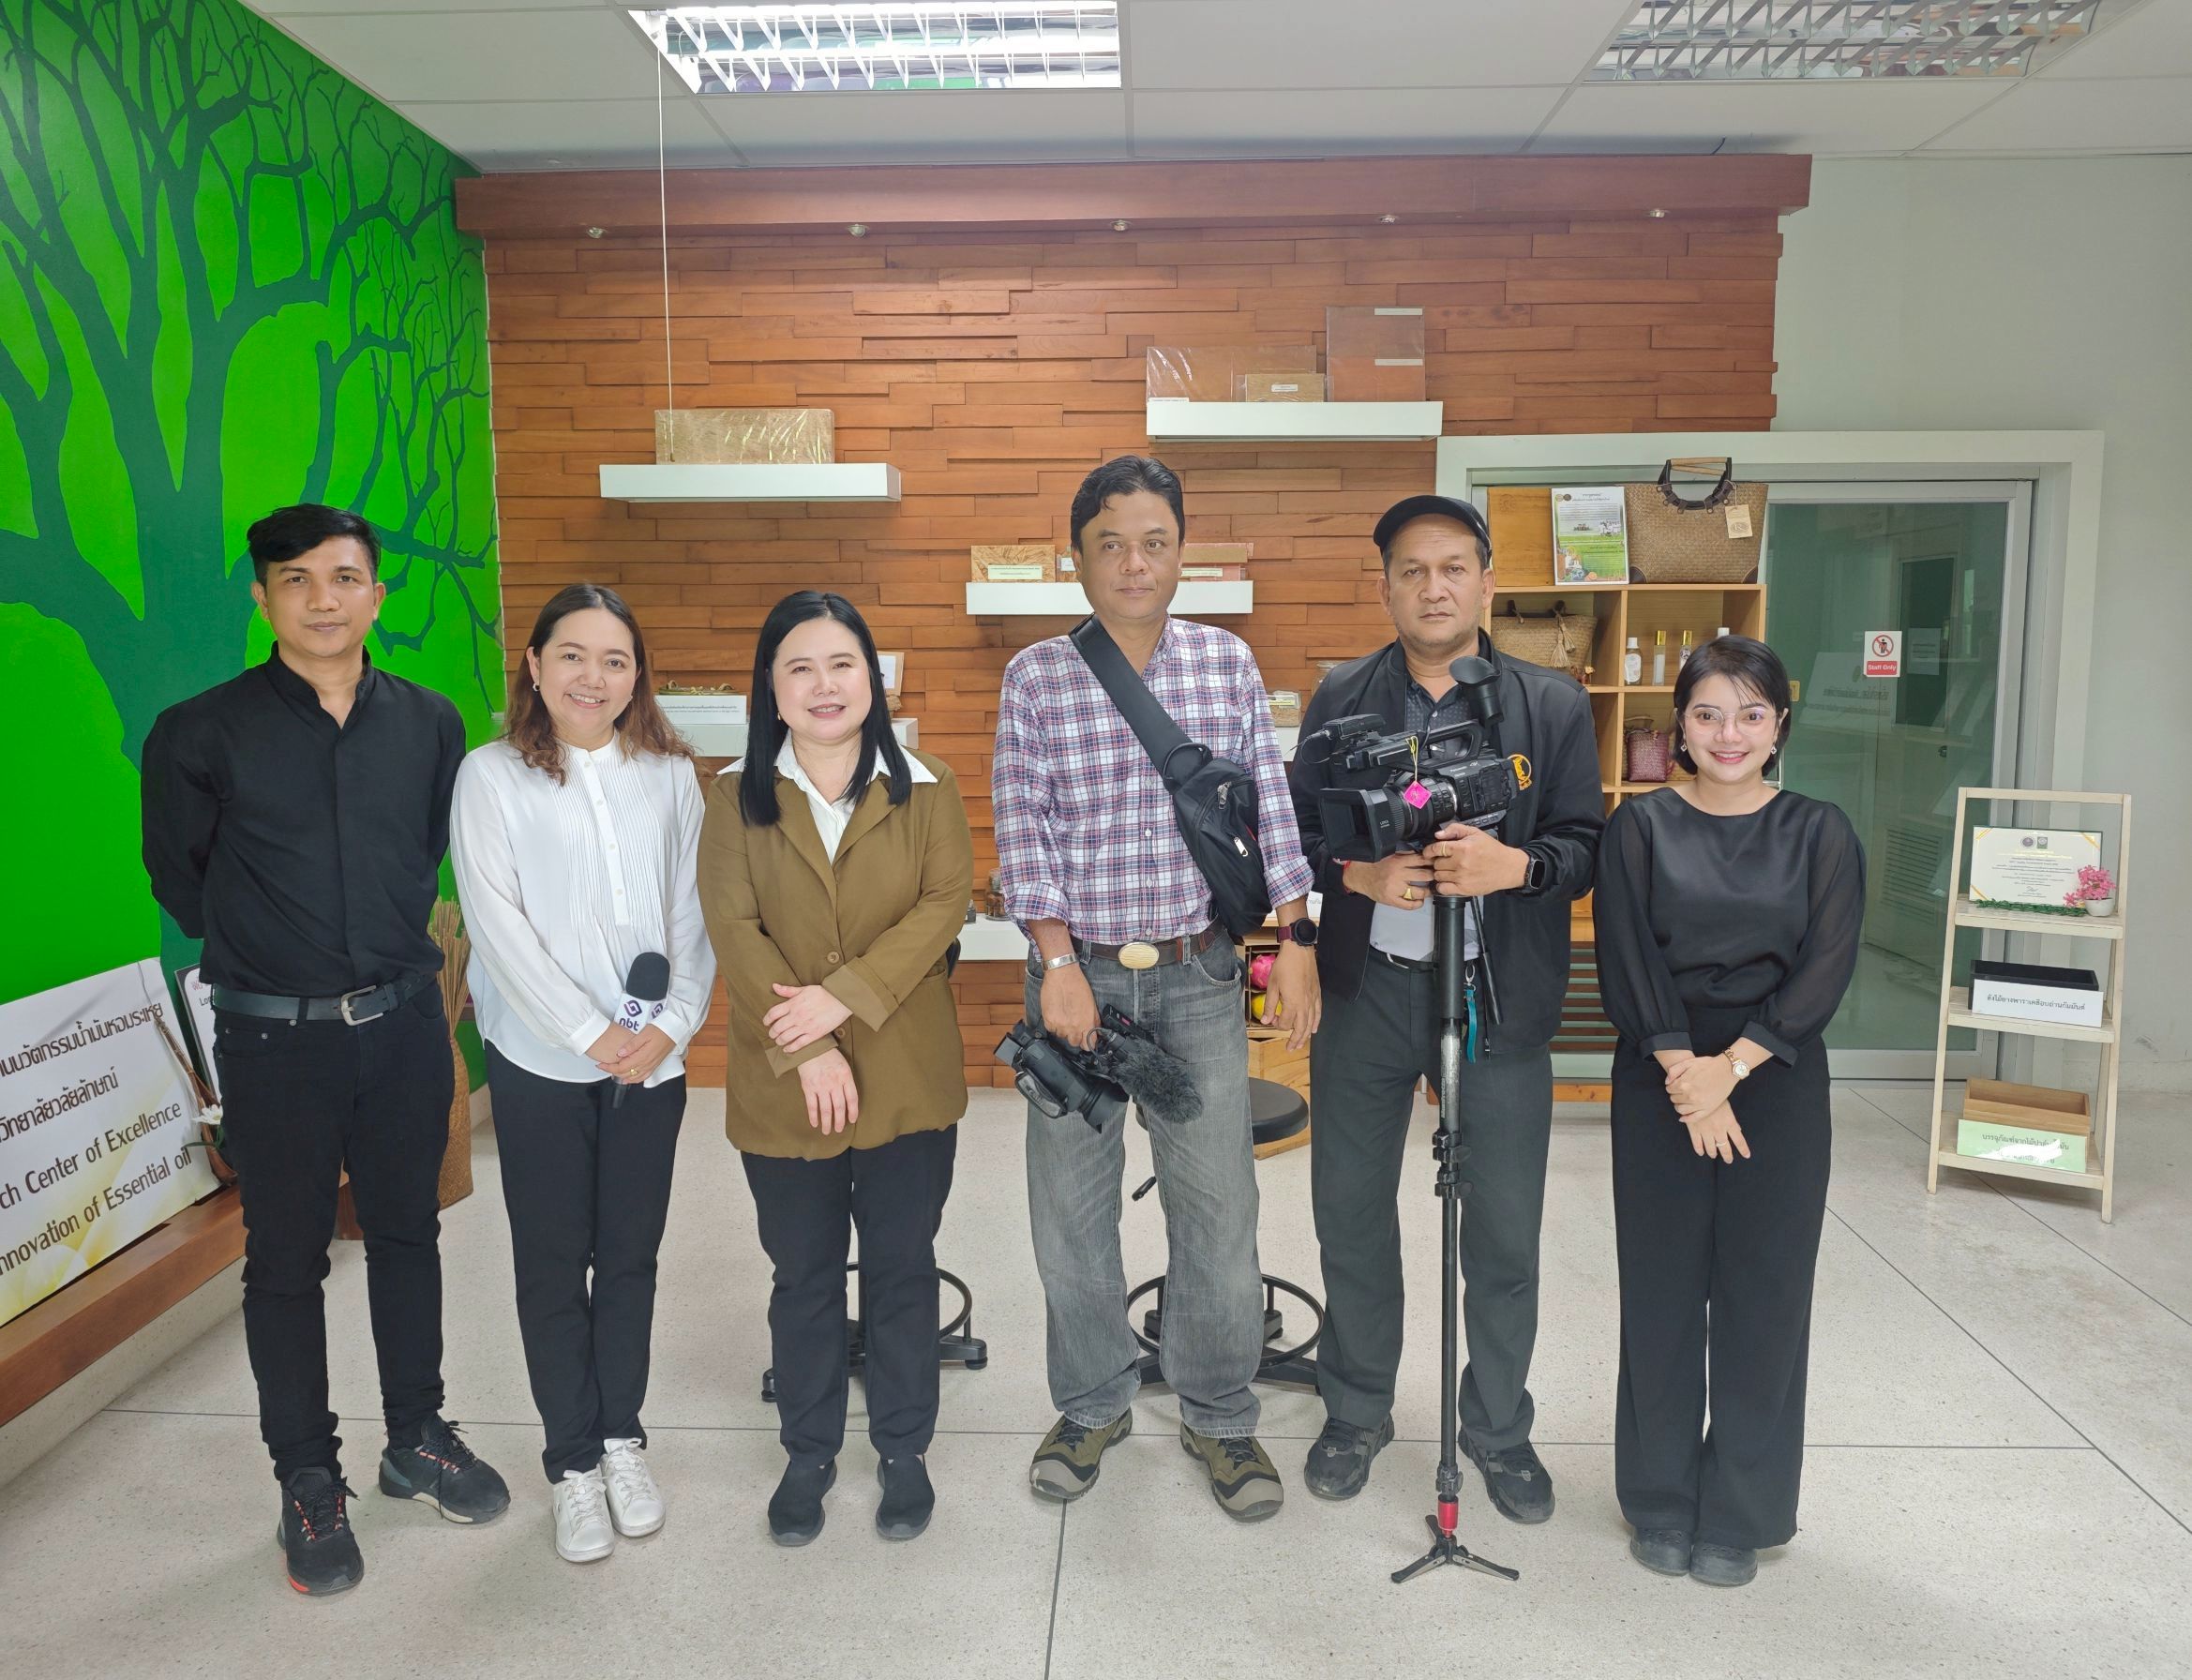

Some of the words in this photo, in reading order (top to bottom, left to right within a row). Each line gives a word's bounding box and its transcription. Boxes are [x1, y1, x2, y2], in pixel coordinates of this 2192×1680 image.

[619, 1017, 639, 1031] nbt
[0, 1066, 119, 1143] วิทยาลัยวลัยลักษณ์
[25, 1153, 79, 1194] Center
[85, 1137, 103, 1163] of
[104, 1102, 182, 1152] Excellence
[83, 1195, 101, 1222] of
[103, 1156, 171, 1210] Essential
[174, 1146, 192, 1170] oil
